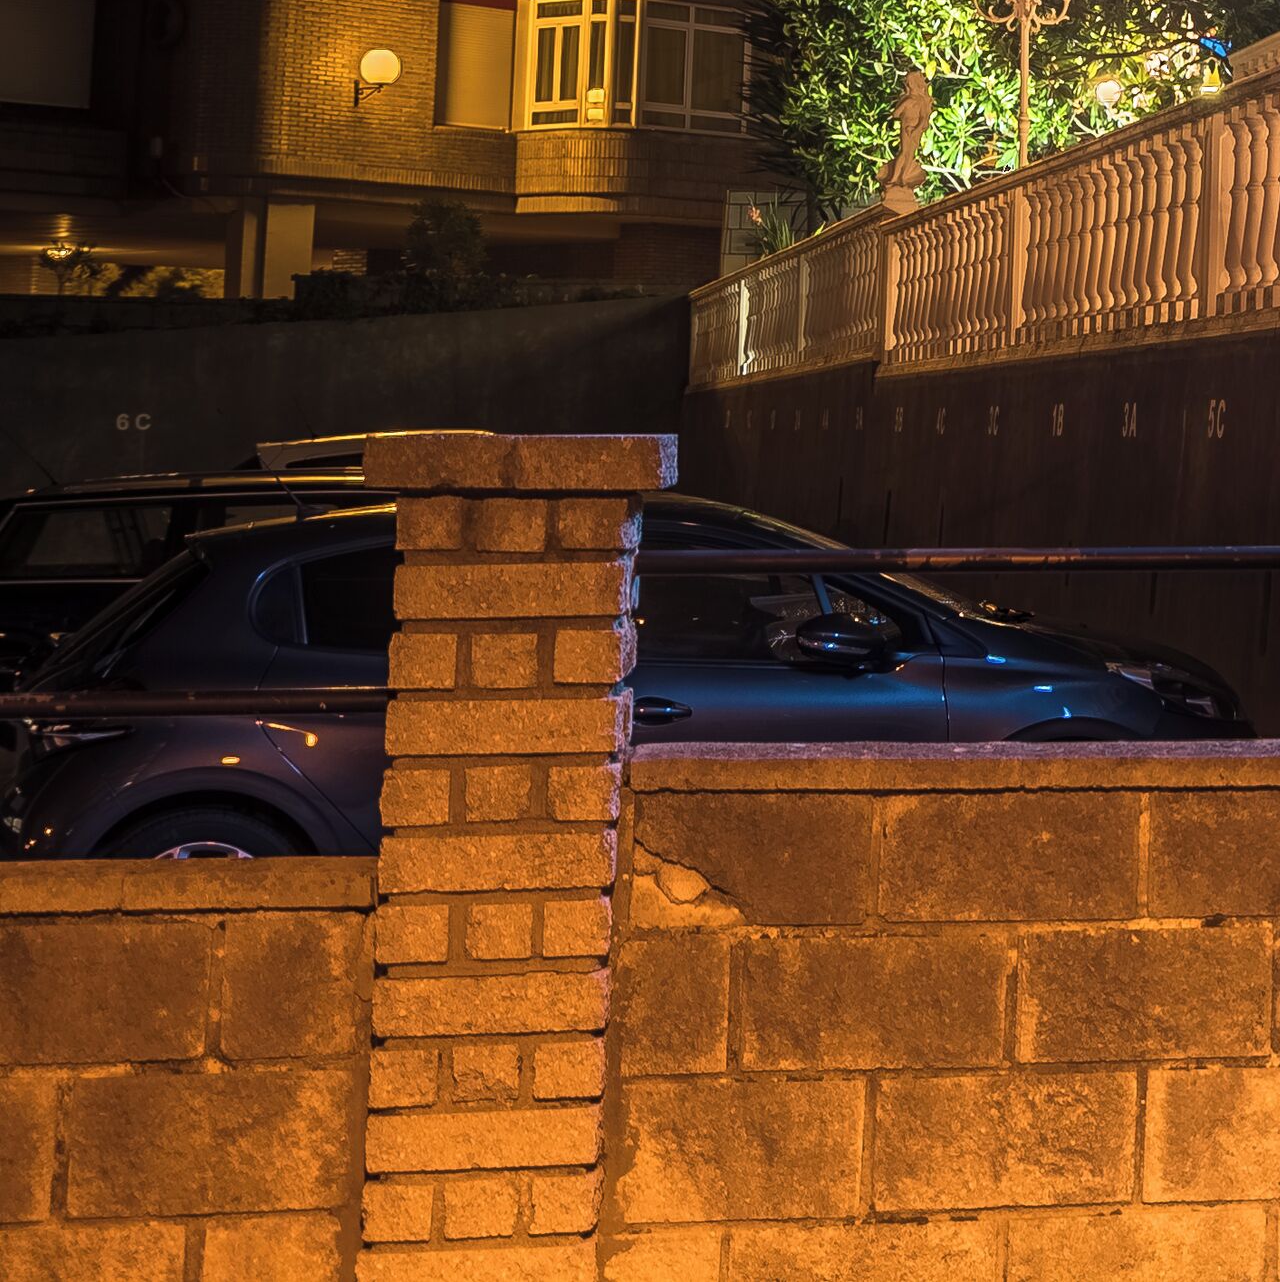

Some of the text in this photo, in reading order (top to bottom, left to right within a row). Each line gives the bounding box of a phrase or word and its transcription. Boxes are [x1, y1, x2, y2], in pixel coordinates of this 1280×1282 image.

[1052, 403, 1064, 437] 1B
[1122, 402, 1137, 438] 3A
[1208, 399, 1226, 439] 5C
